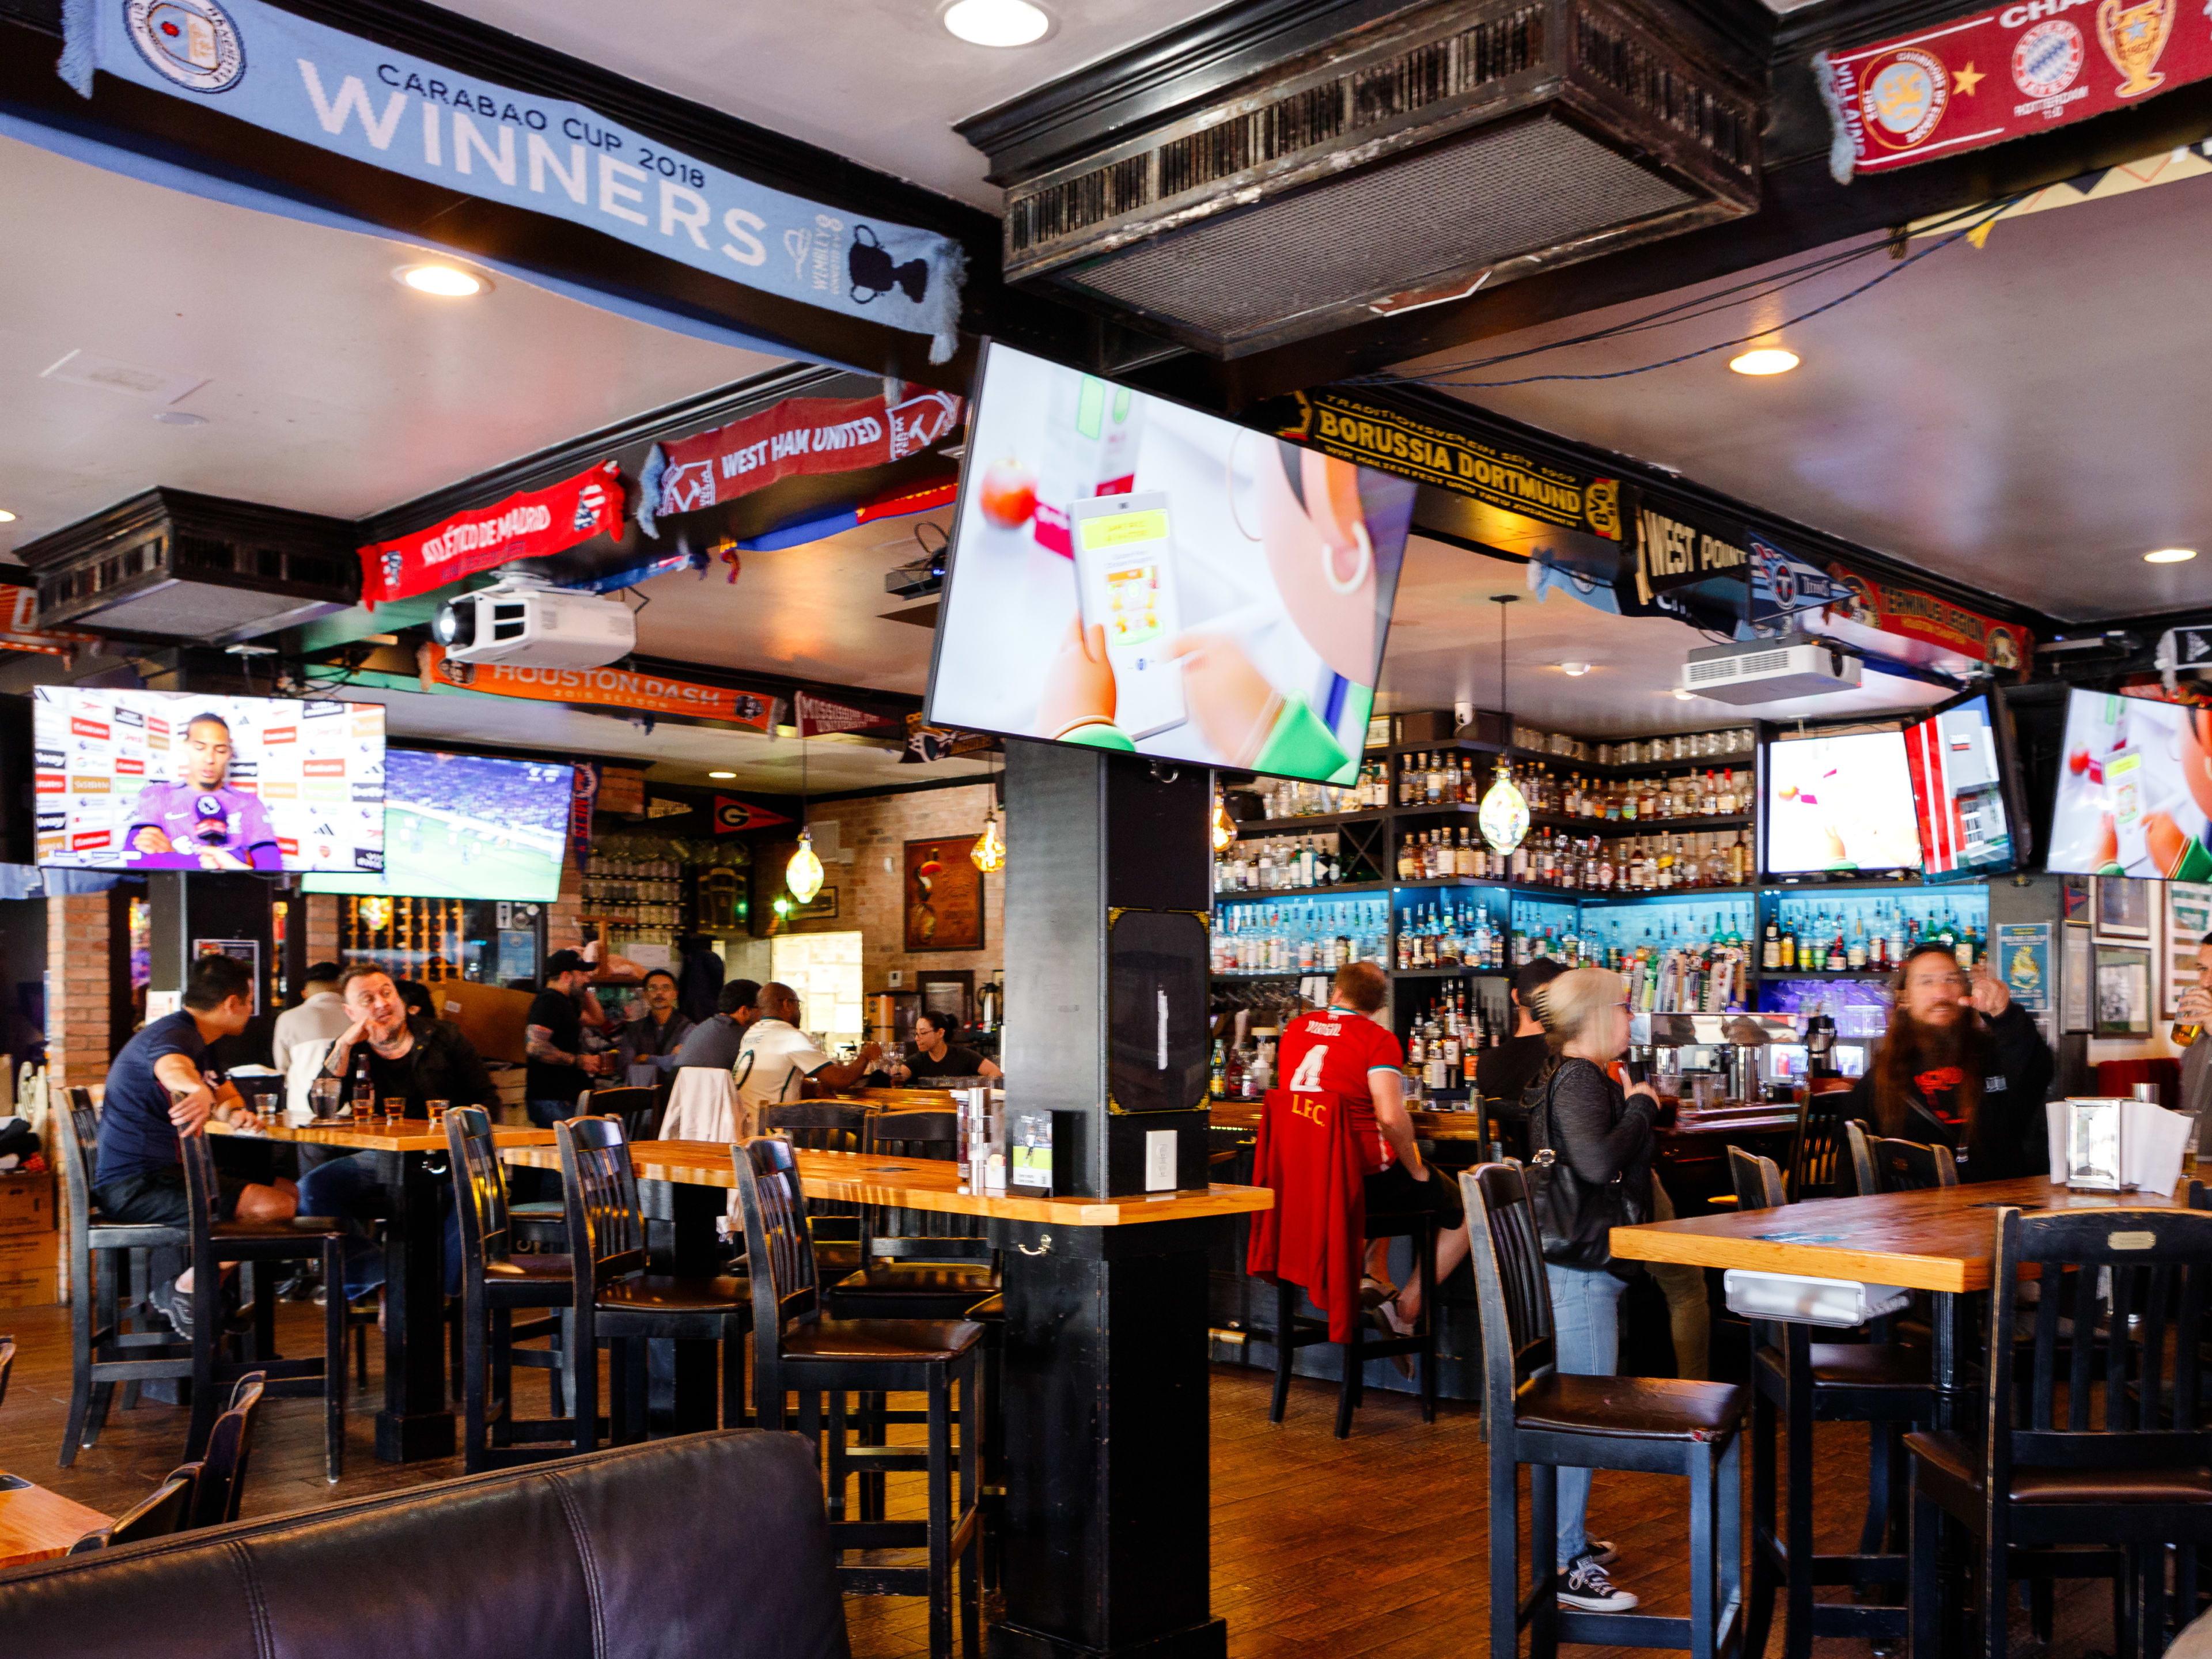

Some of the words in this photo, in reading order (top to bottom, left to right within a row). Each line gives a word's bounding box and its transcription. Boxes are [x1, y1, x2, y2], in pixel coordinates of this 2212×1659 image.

[377, 63, 547, 131] CARABAO
[562, 118, 623, 152] CUP
[638, 147, 706, 190] 2018
[296, 58, 768, 267] WINNERS
[721, 440, 768, 479] WEST
[771, 428, 811, 460] HAM
[812, 416, 882, 452] UNITED
[1319, 409, 1453, 472] BORUSSIA
[1457, 450, 1581, 513] DORTMUND
[497, 504, 552, 543] MADRID
[1643, 509, 1696, 577] WEST
[493, 664, 639, 694] HOUSTON
[645, 679, 720, 707] DASH
[717, 803, 751, 828] G
[1289, 1044, 1330, 1093] 4
